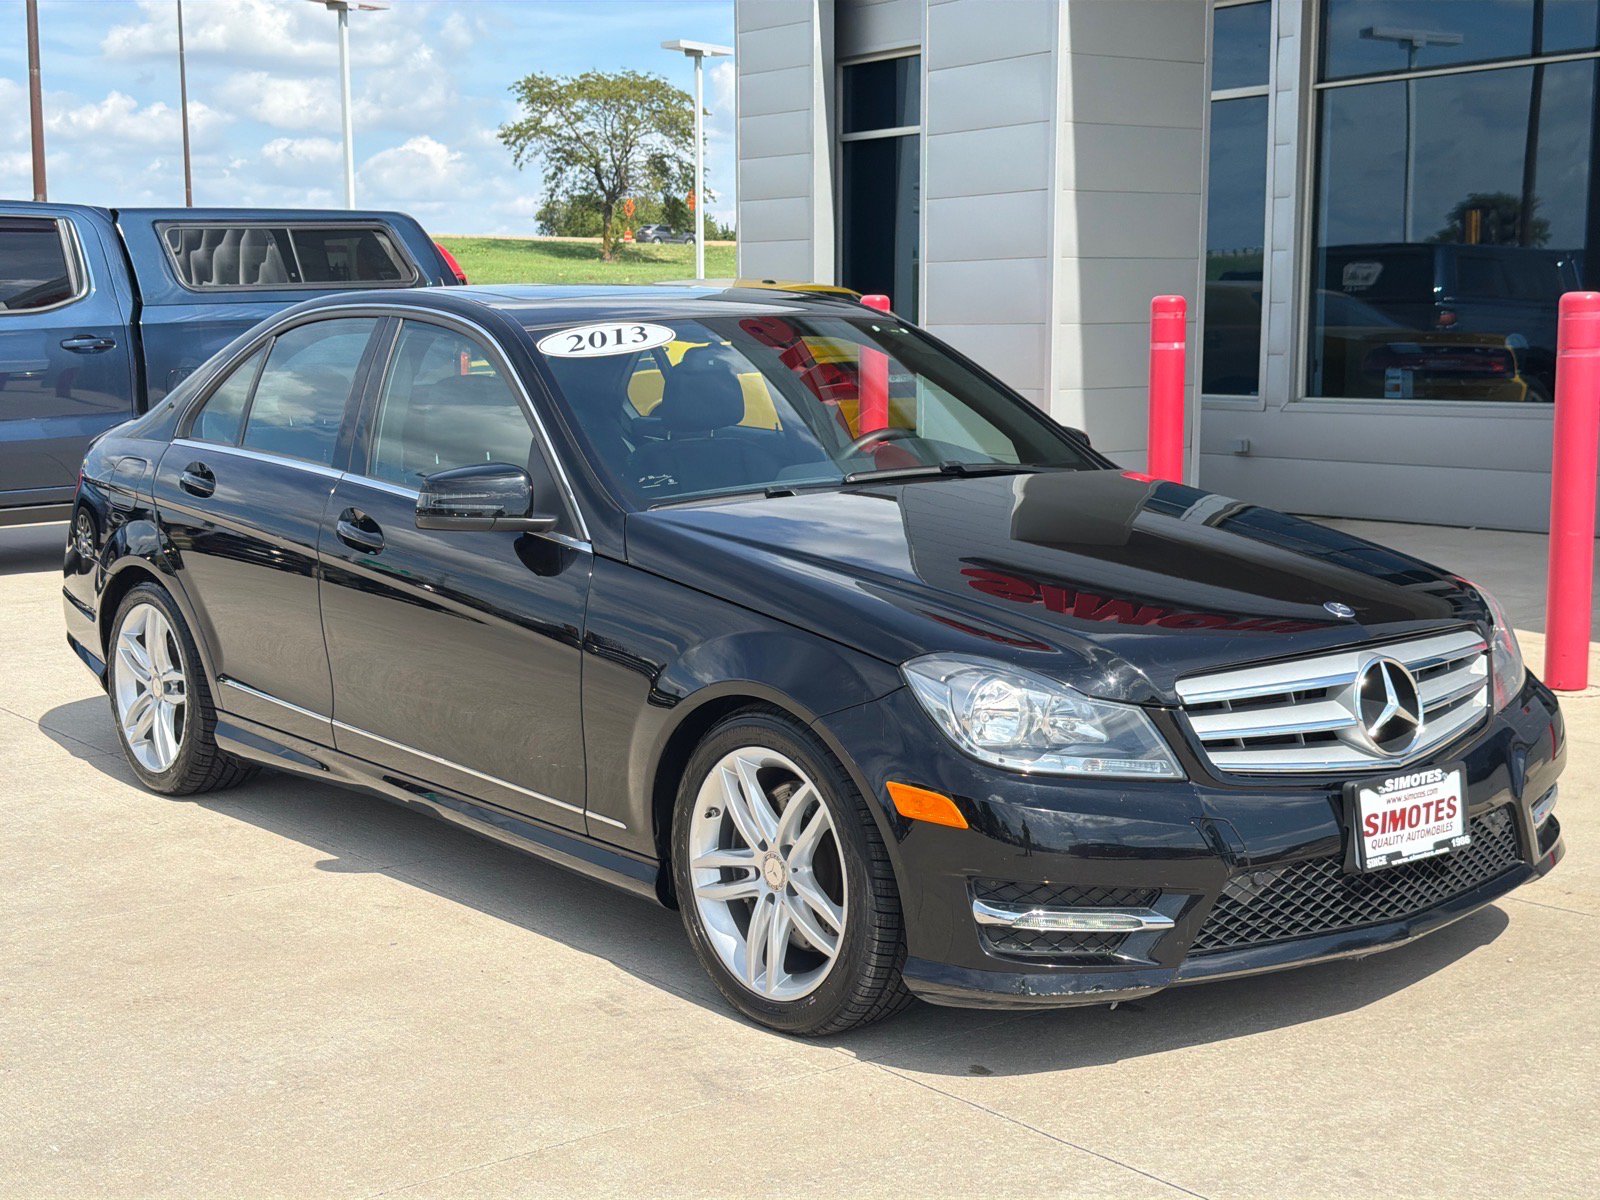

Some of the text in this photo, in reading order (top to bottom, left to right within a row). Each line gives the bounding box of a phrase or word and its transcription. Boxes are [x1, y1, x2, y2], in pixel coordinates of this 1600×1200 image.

[566, 326, 648, 353] 2013
[1384, 769, 1443, 792] SIMOTES
[1363, 796, 1457, 838] SIMOTES
[1371, 821, 1453, 850] QUALITY AUTOMOBILES
[1366, 854, 1388, 869] SINCE
